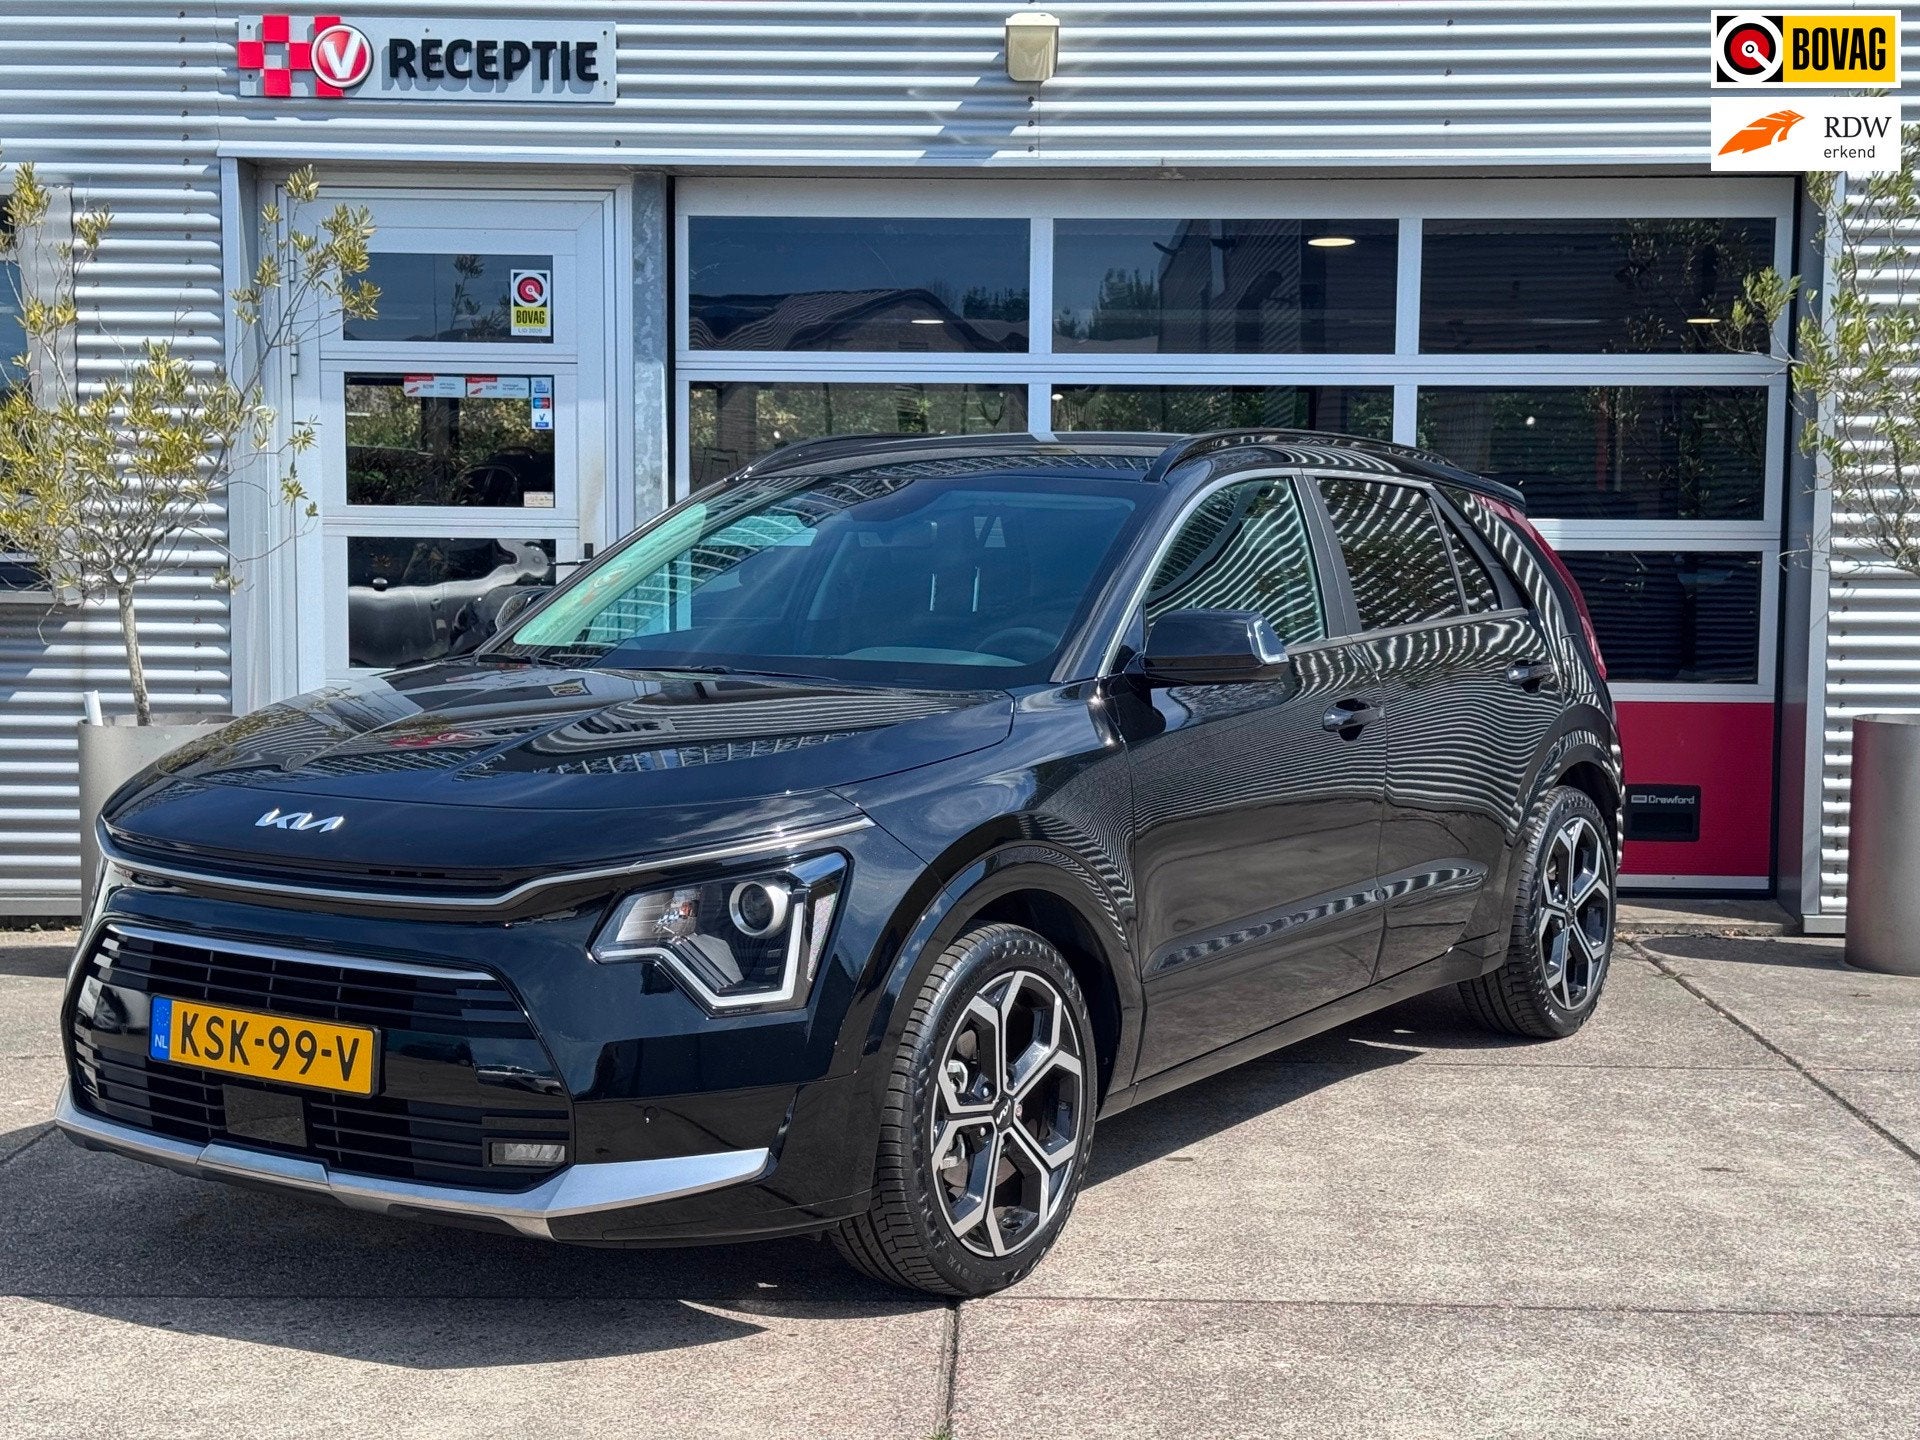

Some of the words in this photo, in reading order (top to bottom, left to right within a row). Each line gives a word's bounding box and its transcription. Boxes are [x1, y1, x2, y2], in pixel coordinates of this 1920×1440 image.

[388, 38, 599, 81] RECEPTIE
[516, 310, 545, 325] BOVAG
[1648, 795, 1695, 804] Crawford
[255, 808, 344, 833] KIA
[154, 1034, 168, 1050] NL
[181, 1011, 360, 1082] KSK-99-V
